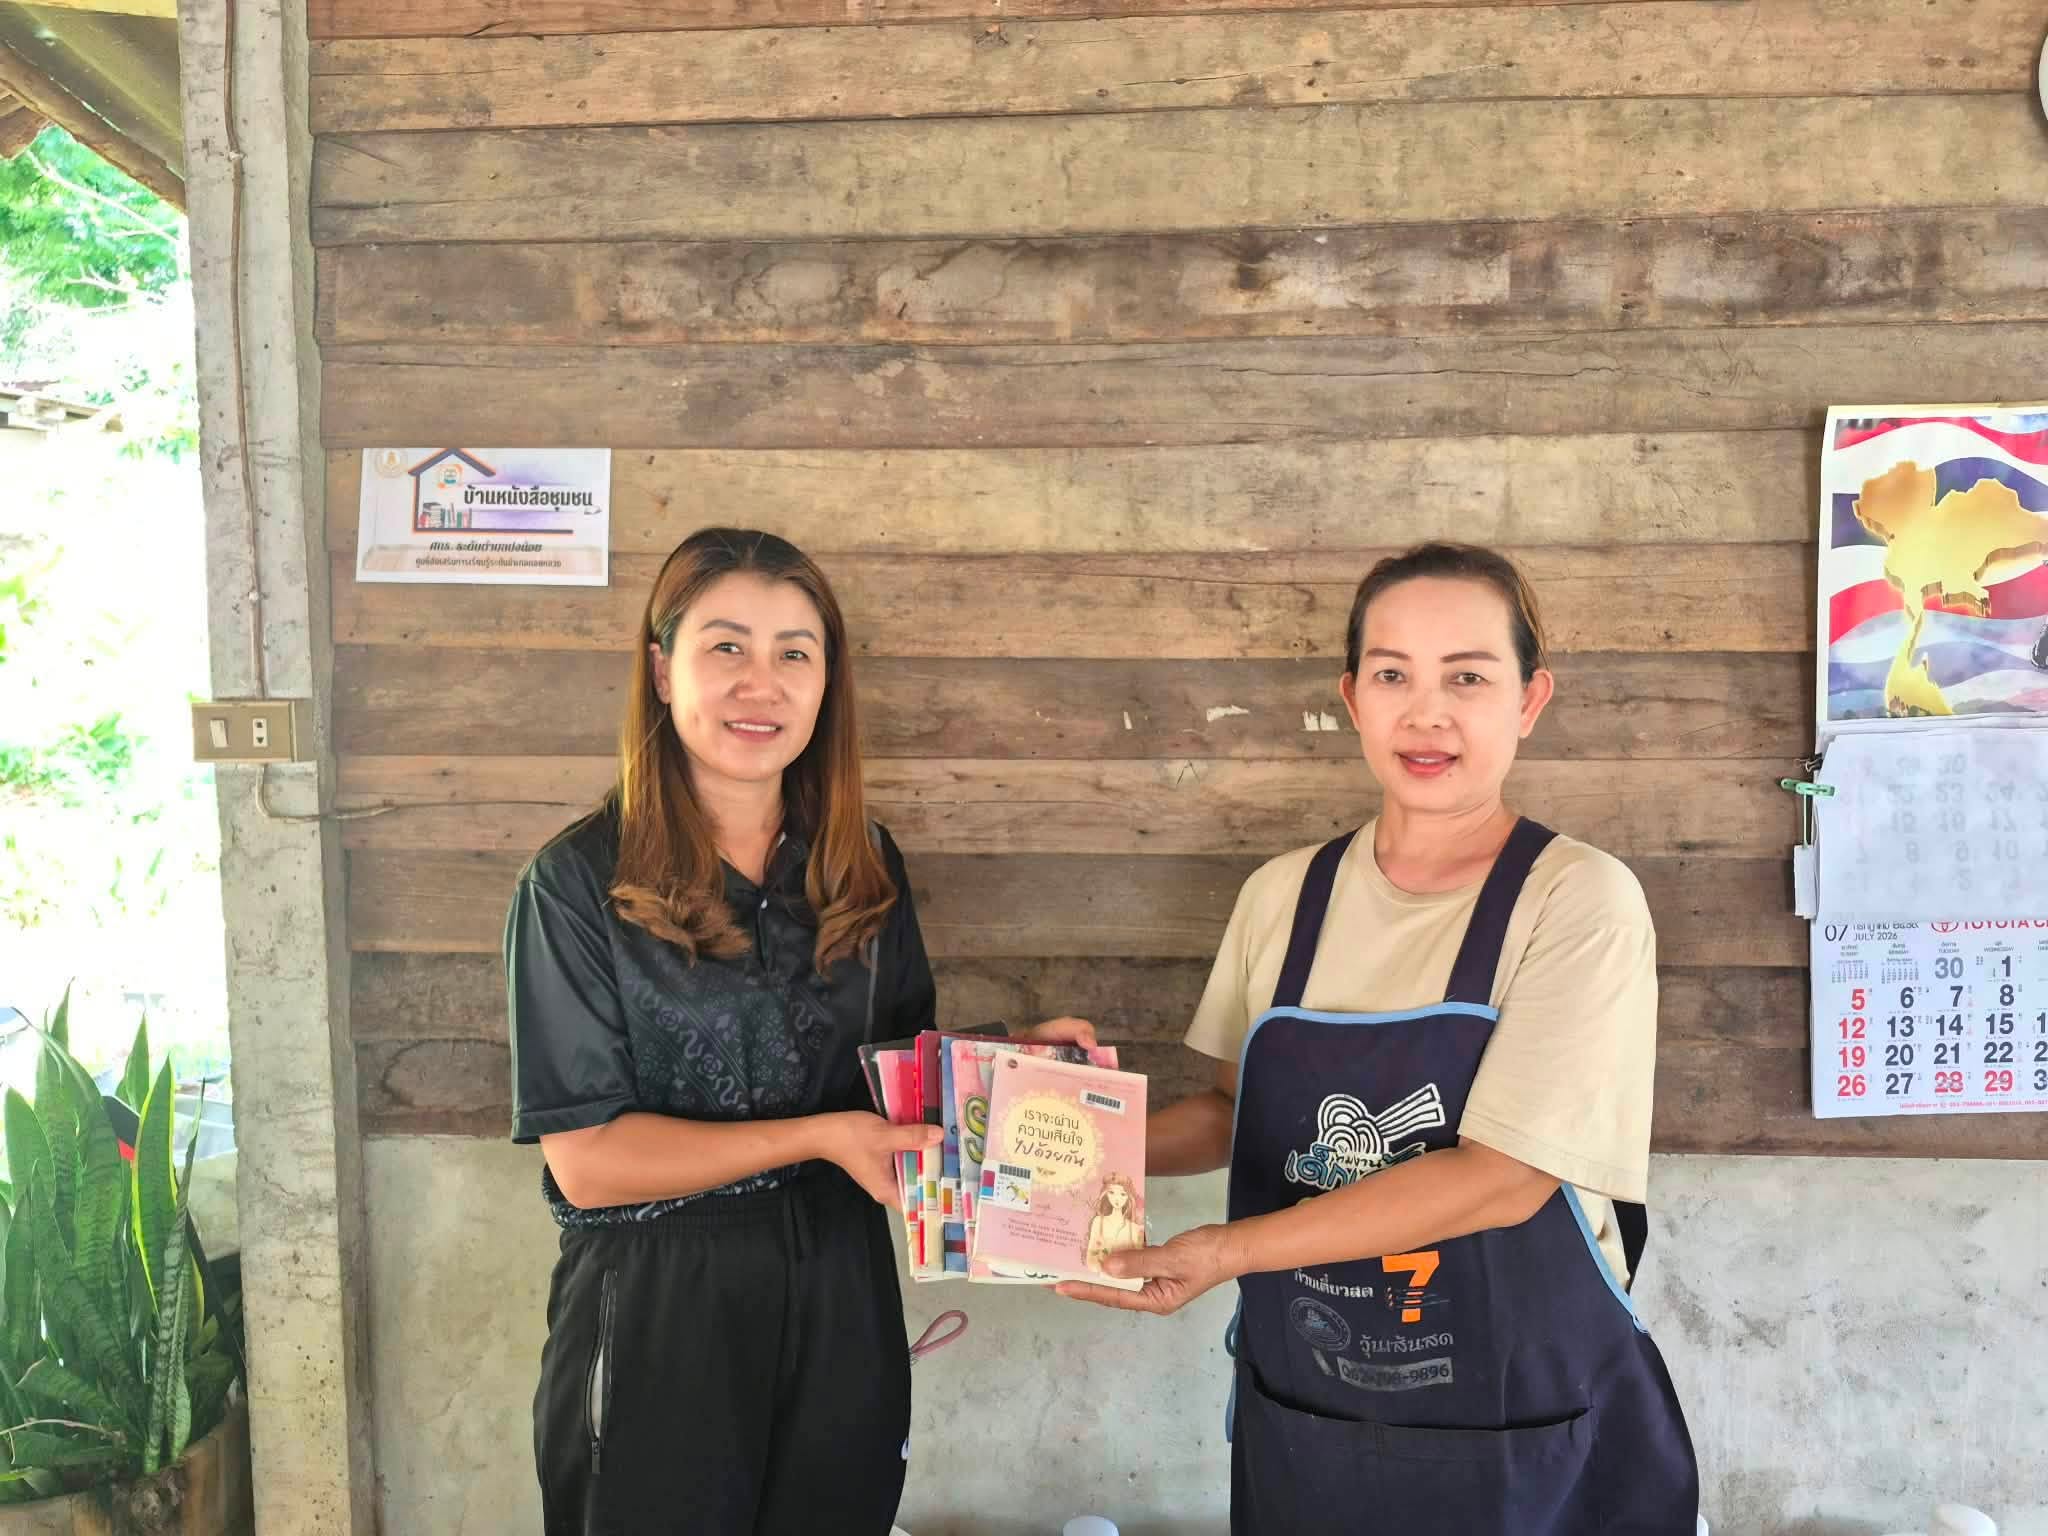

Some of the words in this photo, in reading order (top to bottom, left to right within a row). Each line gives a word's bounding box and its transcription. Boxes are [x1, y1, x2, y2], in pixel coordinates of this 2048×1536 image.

[464, 484, 593, 512] บ้านหนังสือชุมชน
[1854, 933, 1875, 941] JULY
[1877, 932, 1898, 941] 2026
[1934, 957, 1964, 979] 30
[2001, 955, 2012, 978] 1
[1851, 988, 1865, 1011] 5
[1900, 987, 1914, 1009] 6
[1950, 986, 1964, 1007] 7
[2000, 984, 2015, 1007] 8
[1839, 1017, 1866, 1039] 12
[1887, 1016, 1914, 1038] 13
[1936, 1014, 1964, 1036] 14
[1985, 1013, 2014, 1035] 15
[1838, 1046, 1866, 1068] 19
[1885, 1044, 1914, 1066] 20
[1933, 1043, 1960, 1065] 21
[1983, 1042, 2014, 1063] 22
[1837, 1075, 1866, 1097] 26
[1885, 1073, 1914, 1095] 27
[1935, 1071, 1964, 1093] 28
[1984, 1070, 2013, 1092] 29
[1024, 1109, 1079, 1130] เราจะผ่าน
[1018, 1124, 1083, 1147] ความเสียใจ
[1014, 1137, 1085, 1167] ไปด้วยกัน
[1359, 1332, 1454, 1359] วุ้นเส้นสด
